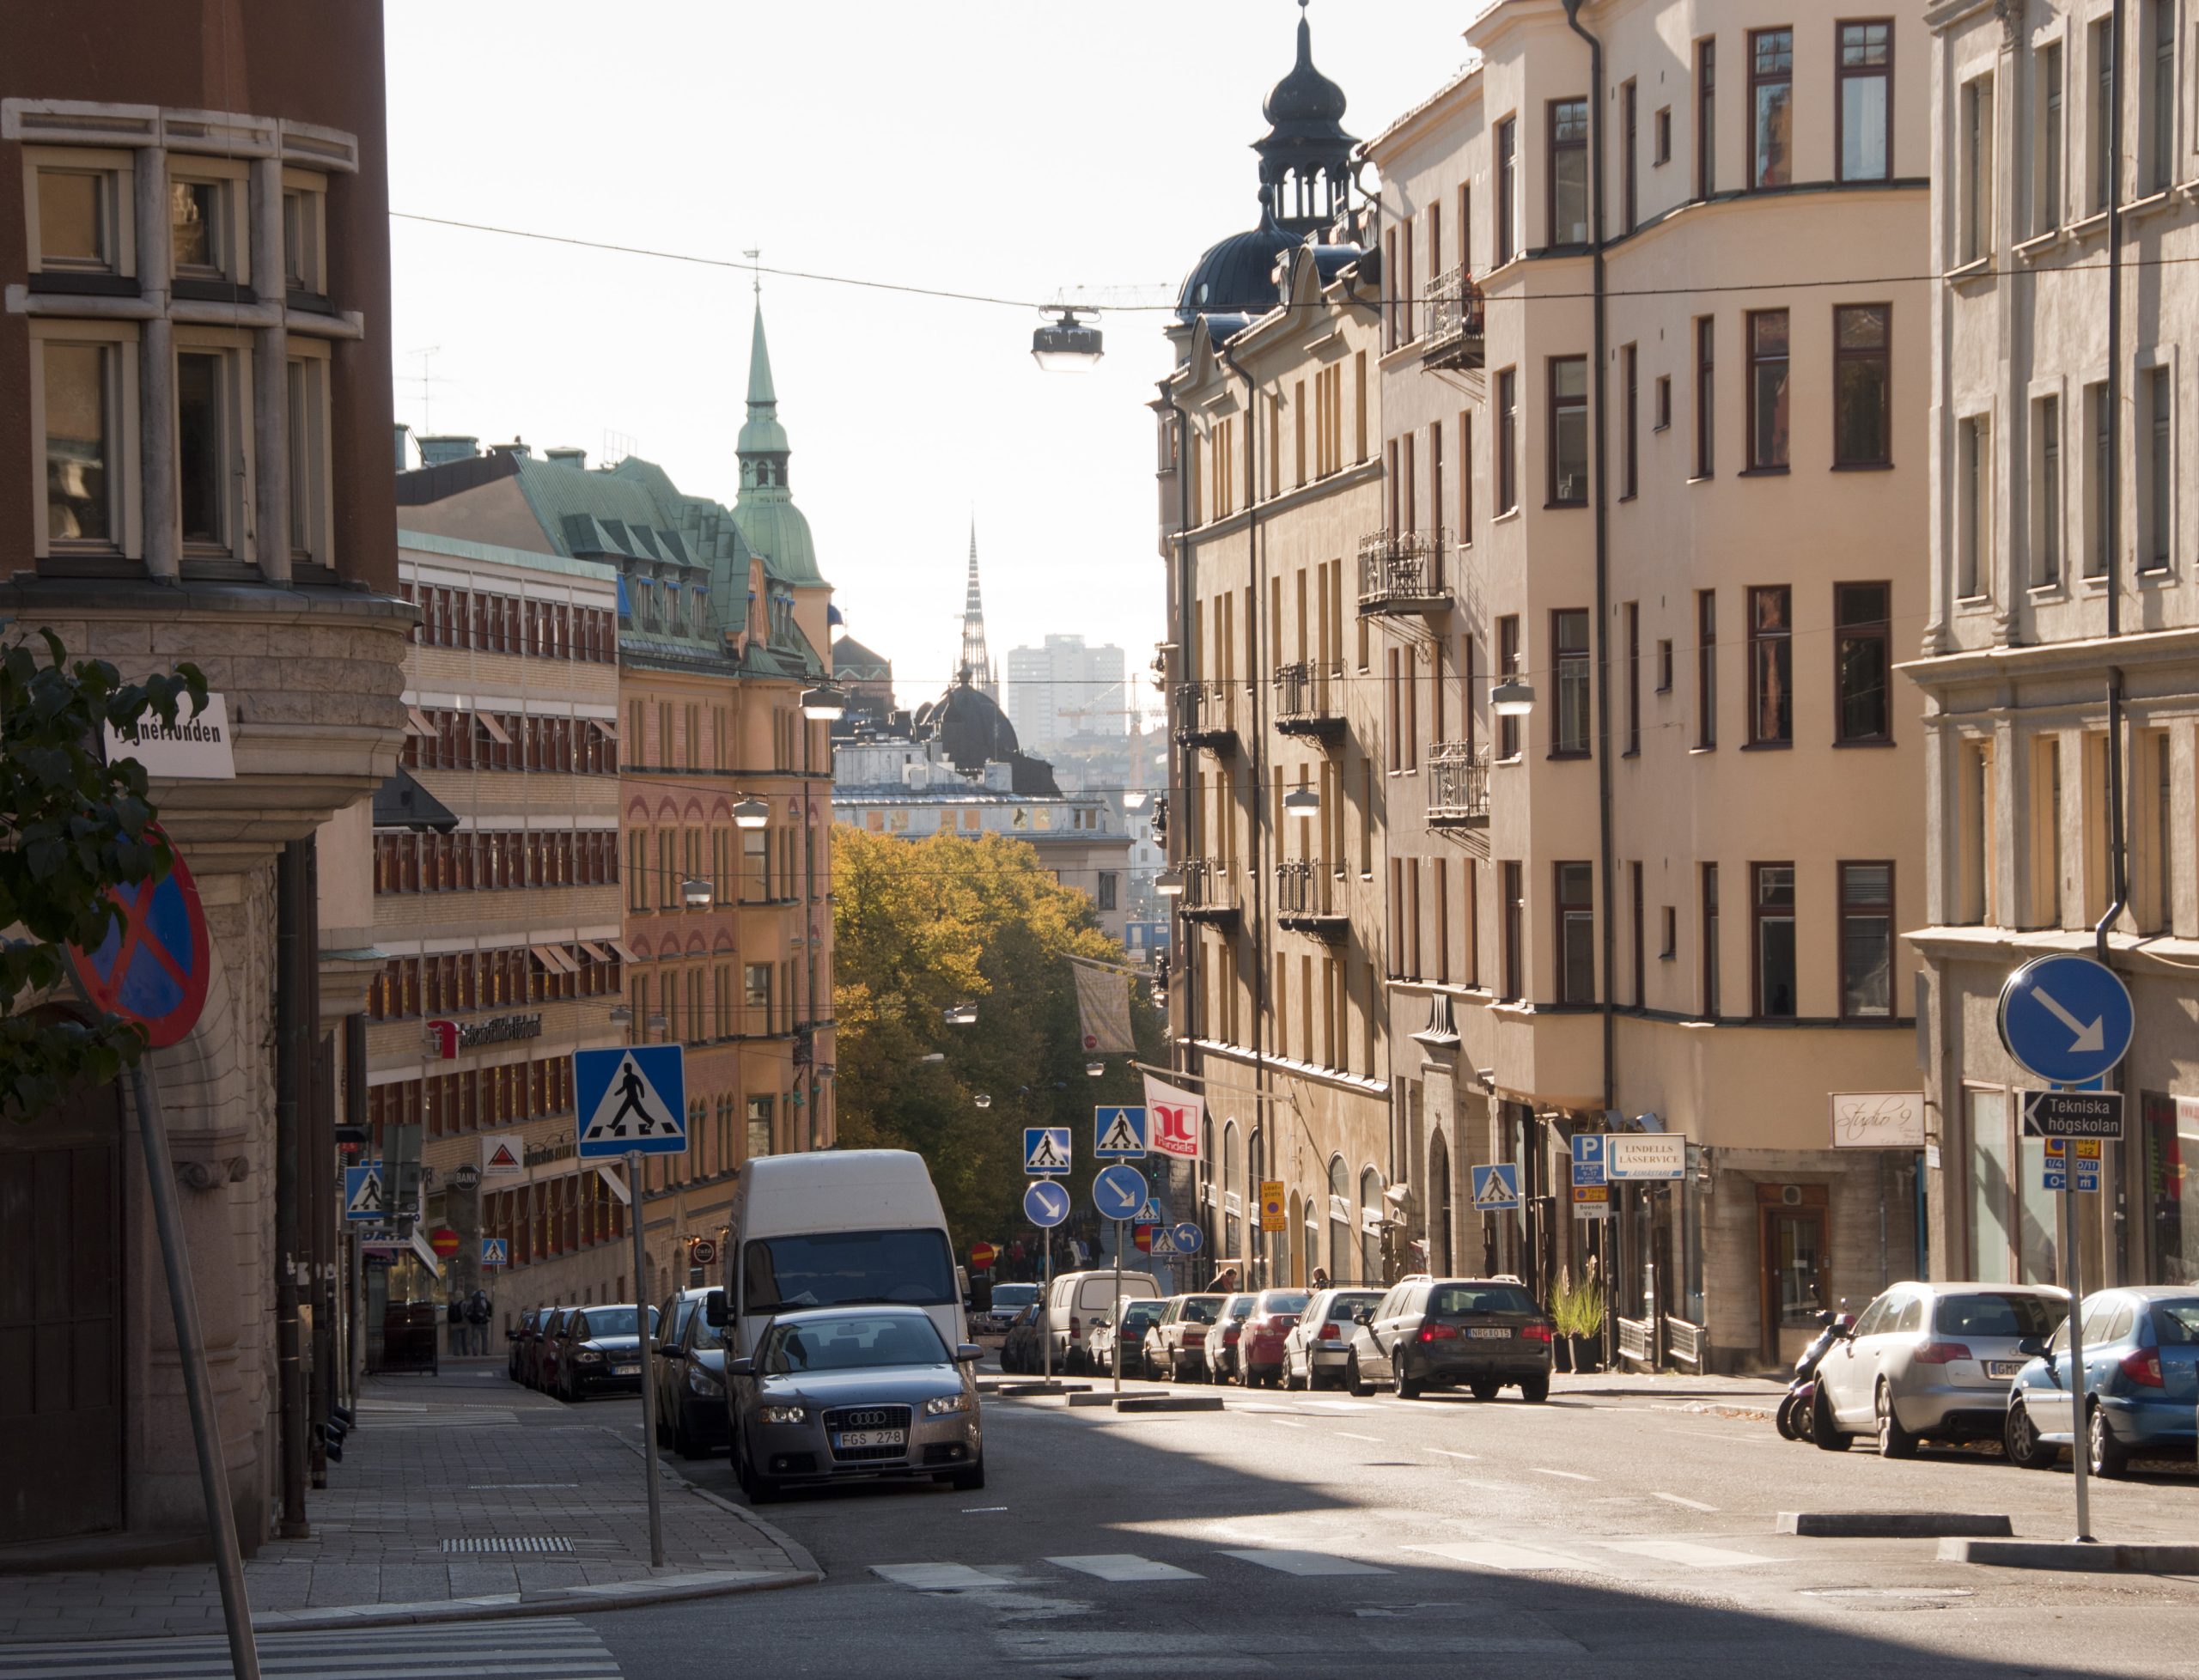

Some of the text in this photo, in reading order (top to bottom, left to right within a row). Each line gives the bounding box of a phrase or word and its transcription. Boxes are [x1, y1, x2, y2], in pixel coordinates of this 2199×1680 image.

[2050, 1099, 2110, 1114] Tekniska
[1837, 1095, 1912, 1141] Studio 9
[2048, 1117, 2119, 1133] högskolan
[1158, 1135, 1194, 1153] Handels
[1581, 1137, 1598, 1160] P
[1619, 1154, 1680, 1164] LÅSSERVICE
[2048, 1159, 2062, 1167] 1/4
[455, 1174, 478, 1184] BANK
[1471, 1329, 1510, 1337] NRG 015
[842, 1431, 901, 1446] FGS 278
